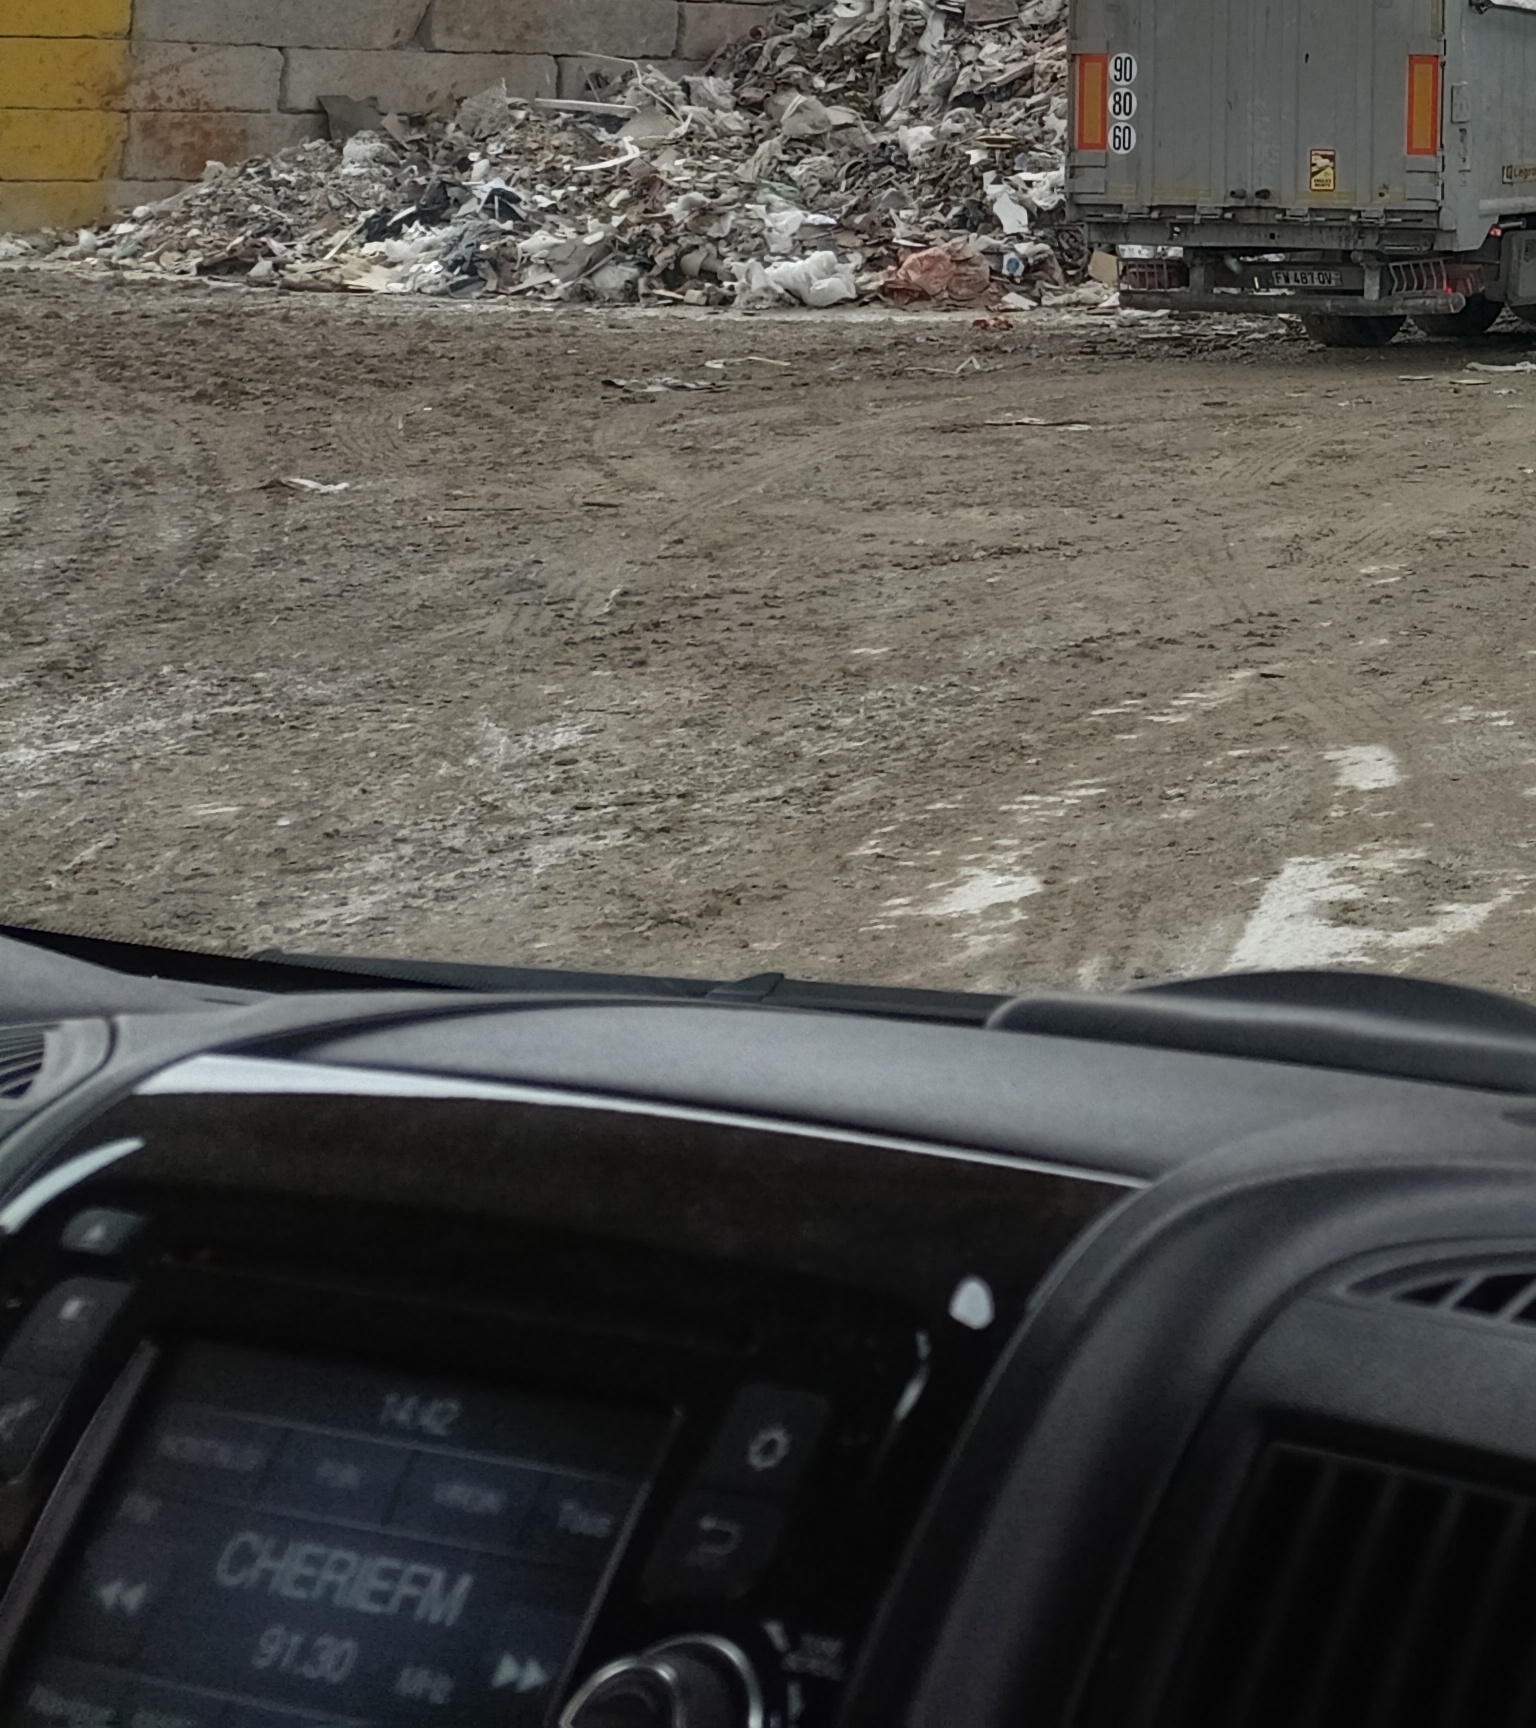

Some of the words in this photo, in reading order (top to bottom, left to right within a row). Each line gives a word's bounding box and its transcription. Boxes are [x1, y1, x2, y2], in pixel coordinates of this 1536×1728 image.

[1113, 56, 1133, 82] 90
[1112, 91, 1133, 117] 80
[1112, 125, 1132, 151] 60
